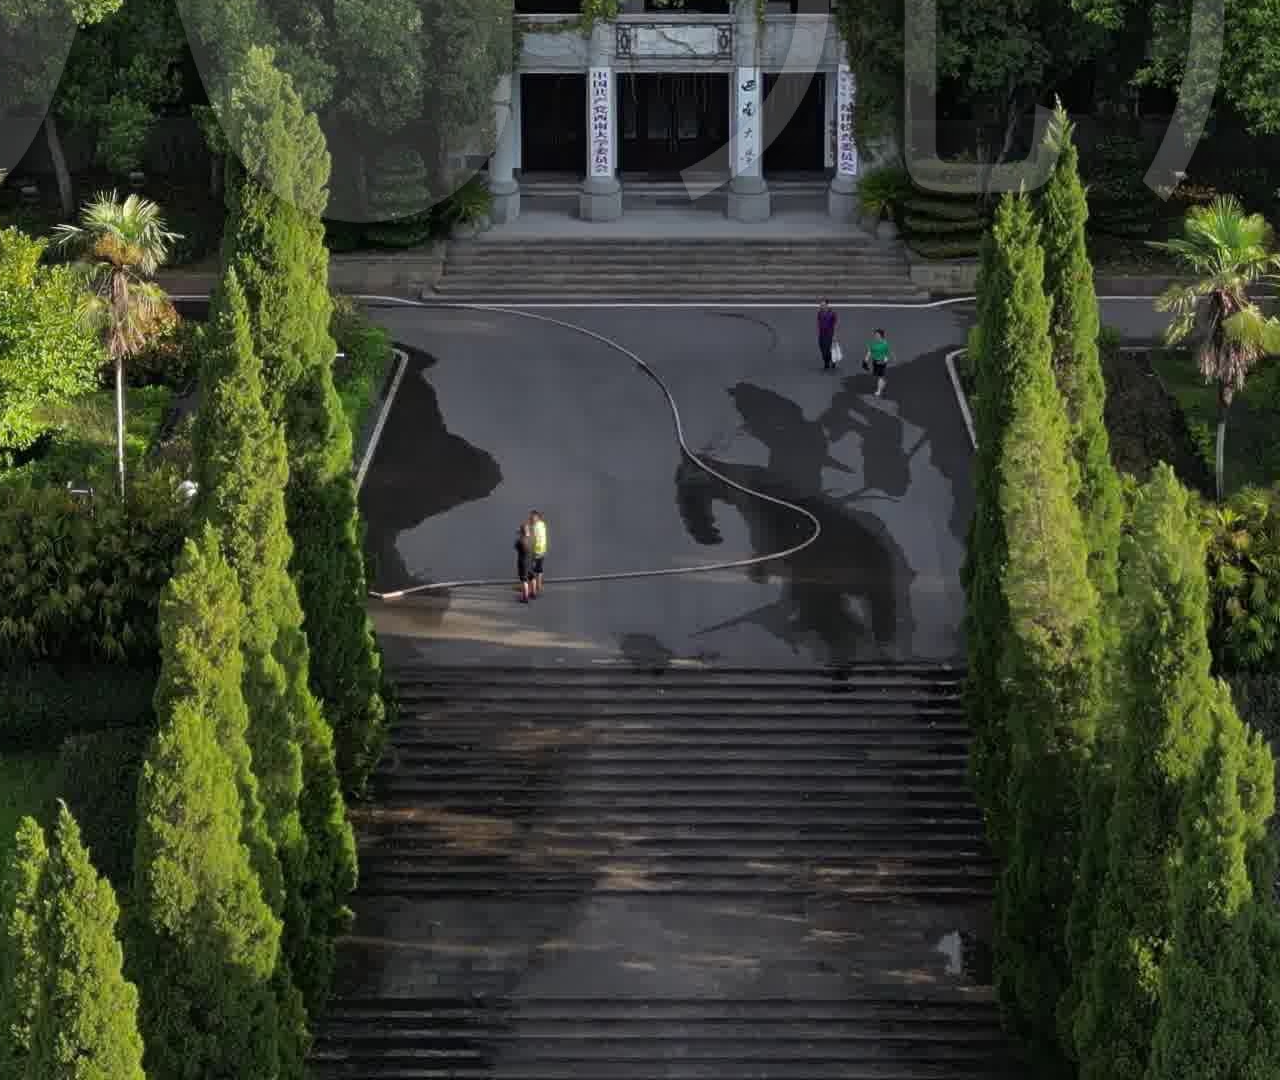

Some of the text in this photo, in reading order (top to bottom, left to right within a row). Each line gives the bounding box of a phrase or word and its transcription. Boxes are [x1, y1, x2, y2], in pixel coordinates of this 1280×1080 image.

[592, 71, 609, 173] 中国共产党西南大学委员会
